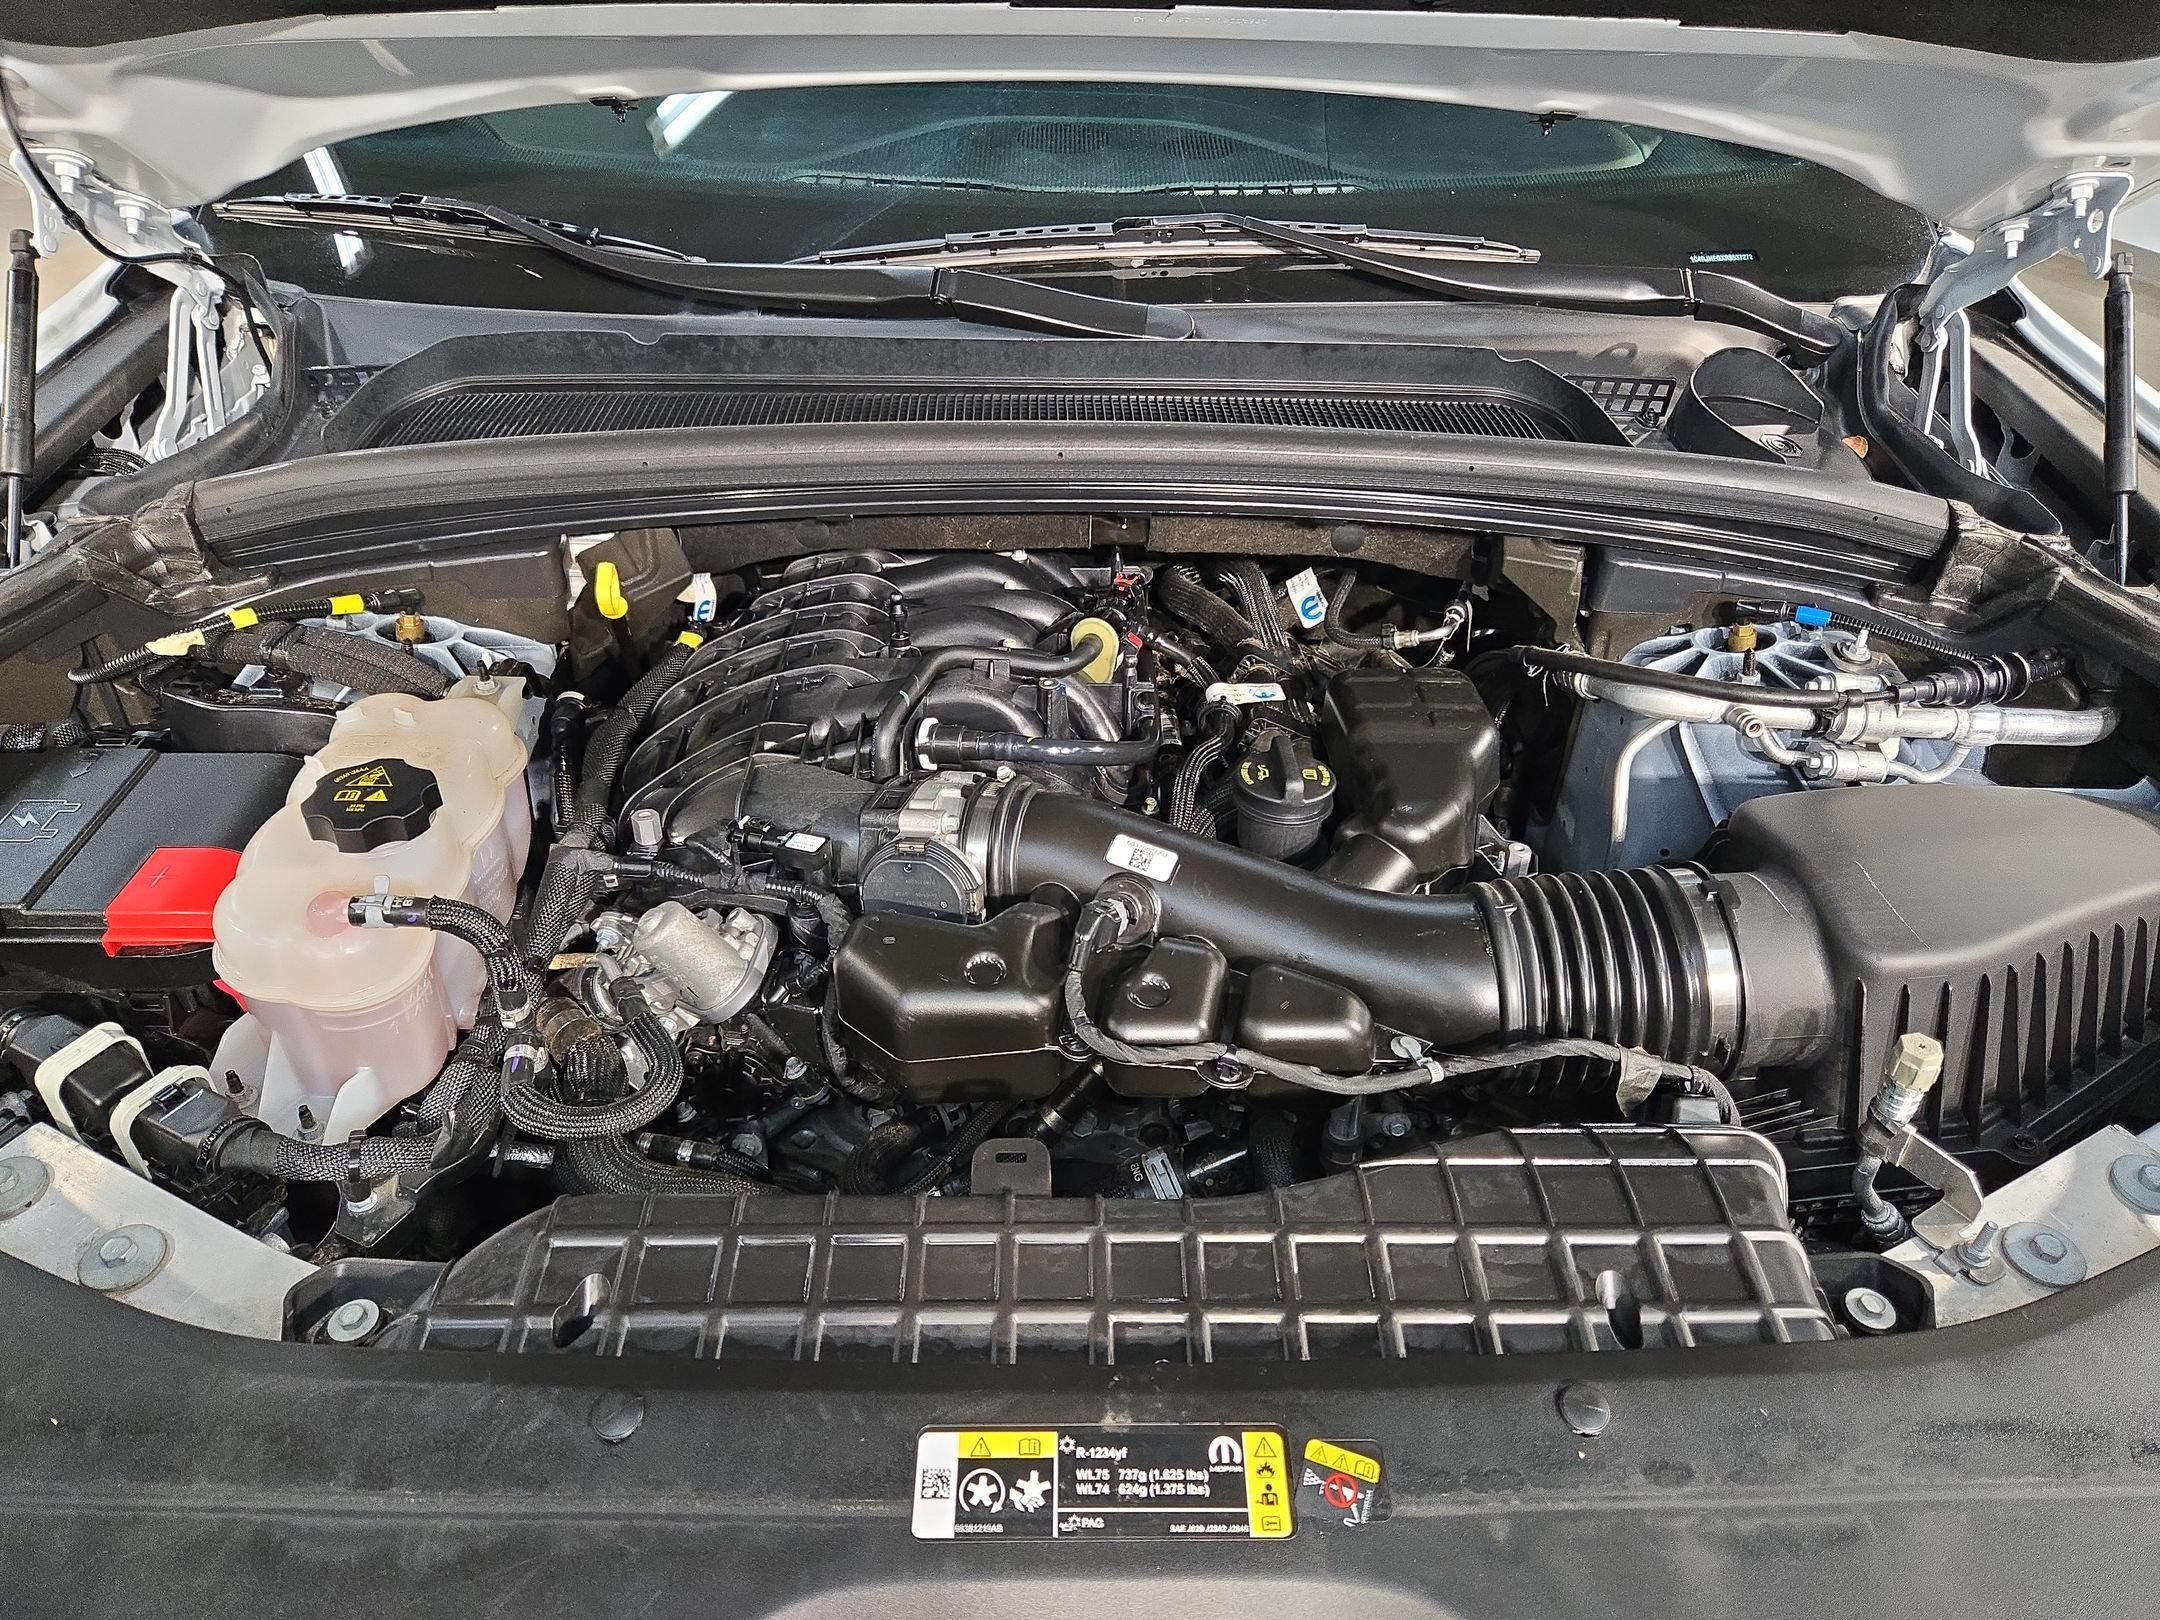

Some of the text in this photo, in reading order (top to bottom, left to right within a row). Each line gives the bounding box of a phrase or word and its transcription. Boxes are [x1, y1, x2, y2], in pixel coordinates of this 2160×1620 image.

[1130, 1162, 1144, 1182] ENG
[1075, 1447, 1128, 1461] R-1234yf
[1075, 1468, 1209, 1482] WL75 737g (1.625 lbs)
[1209, 1465, 1243, 1473] MOPAR
[1075, 1483, 1210, 1497] WL74 624g (1.375 lbs)
[1081, 1517, 1104, 1528] PAG
[1169, 1524, 1186, 1532] SAE
